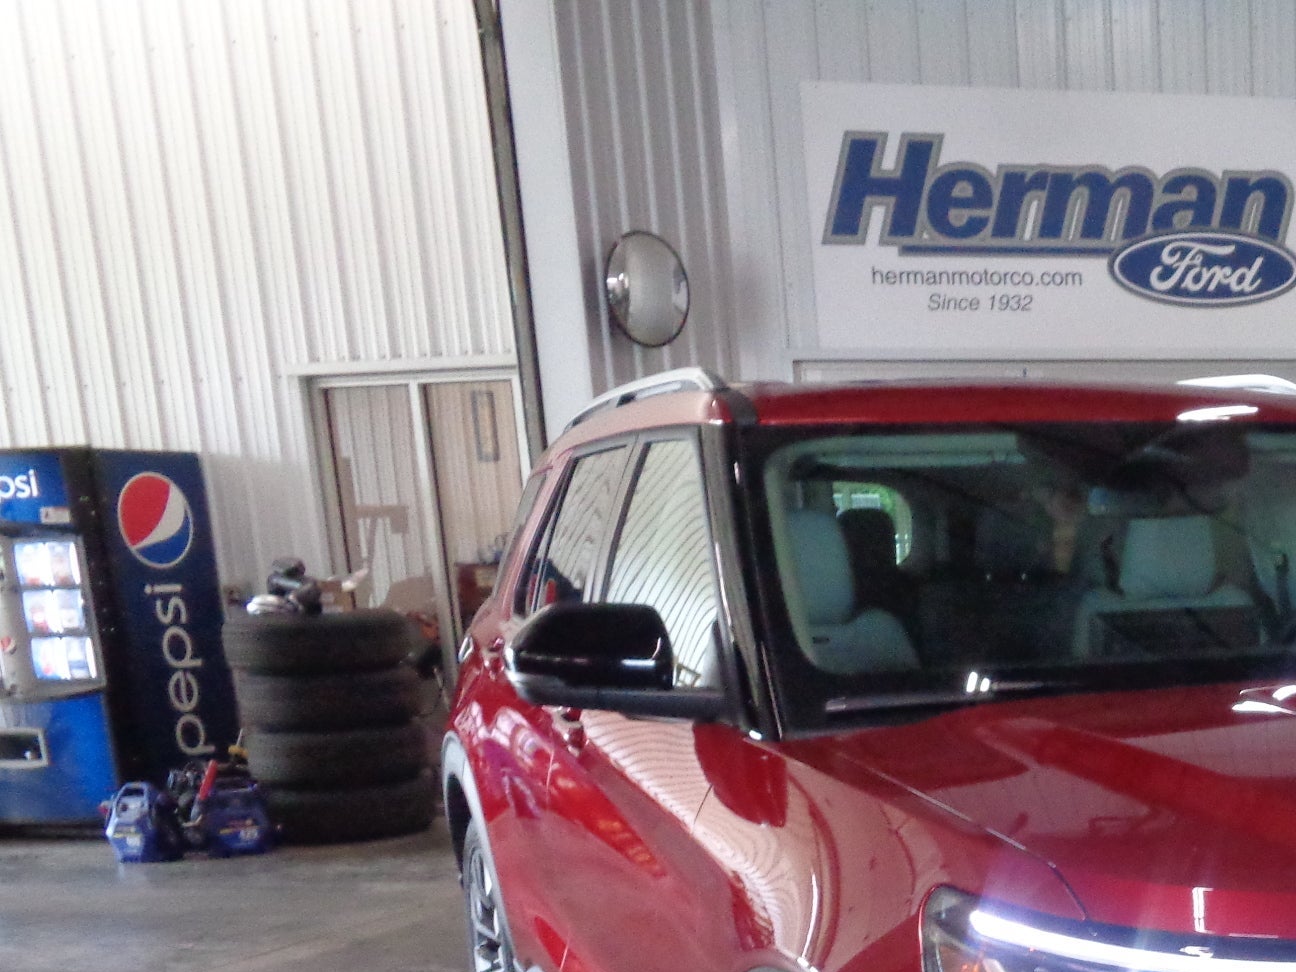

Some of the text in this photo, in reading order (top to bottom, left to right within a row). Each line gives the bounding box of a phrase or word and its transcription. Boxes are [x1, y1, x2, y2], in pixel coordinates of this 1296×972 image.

[823, 130, 1294, 246] Herman
[871, 265, 1083, 288] hermanmotorco.com
[1149, 241, 1263, 293] Ford
[927, 293, 1034, 312] Since 1932
[144, 583, 216, 756] pepsi
